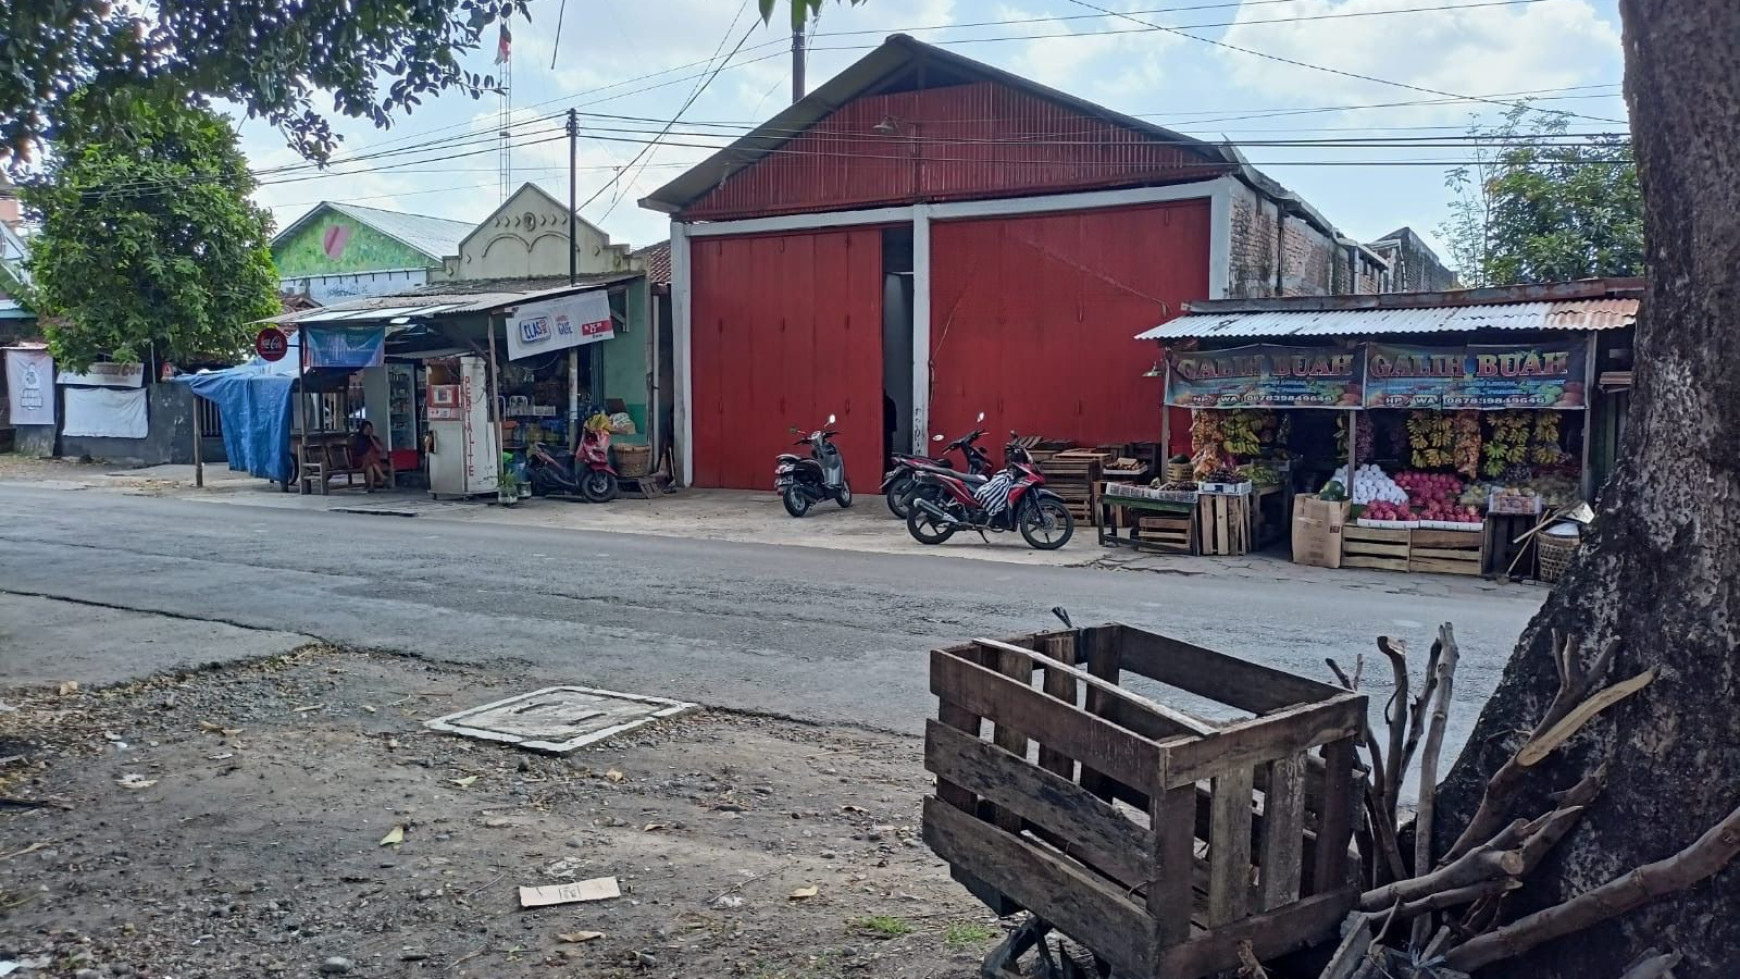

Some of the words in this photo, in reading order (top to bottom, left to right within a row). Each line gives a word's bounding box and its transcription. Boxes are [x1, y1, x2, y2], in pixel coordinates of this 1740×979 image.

[1177, 355, 1265, 379] GALIH
[1270, 354, 1354, 376] BUAH
[1370, 354, 1467, 377] GALIH
[1477, 352, 1568, 376] BUAH
